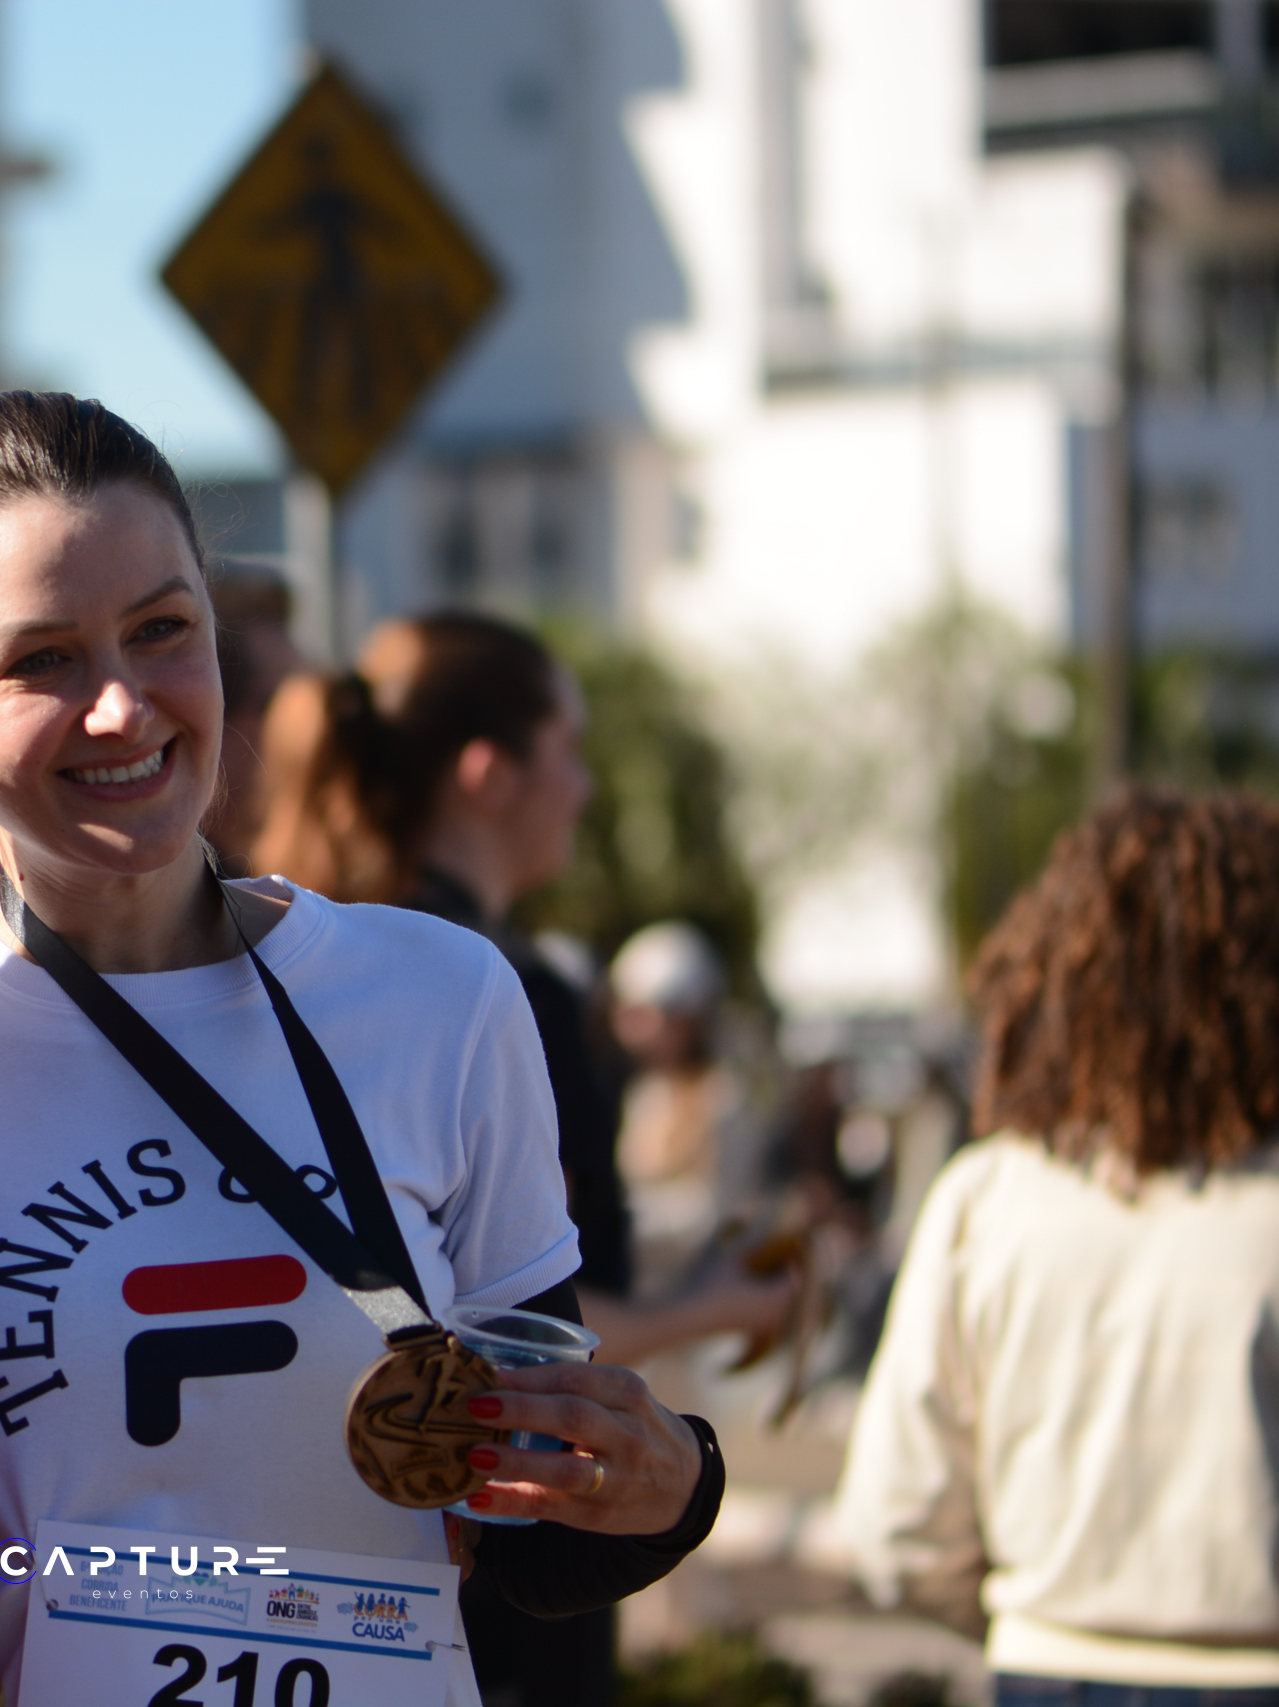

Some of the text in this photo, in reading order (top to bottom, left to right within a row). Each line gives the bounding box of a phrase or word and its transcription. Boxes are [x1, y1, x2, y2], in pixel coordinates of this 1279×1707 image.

[81, 1578, 119, 1592] CORRIDA
[69, 1593, 127, 1612] BENEFICENTE
[208, 1596, 244, 1613] AJUDA
[266, 1599, 296, 1619] ONG
[352, 1622, 406, 1642] CAUSA
[147, 1643, 330, 1707] 210
